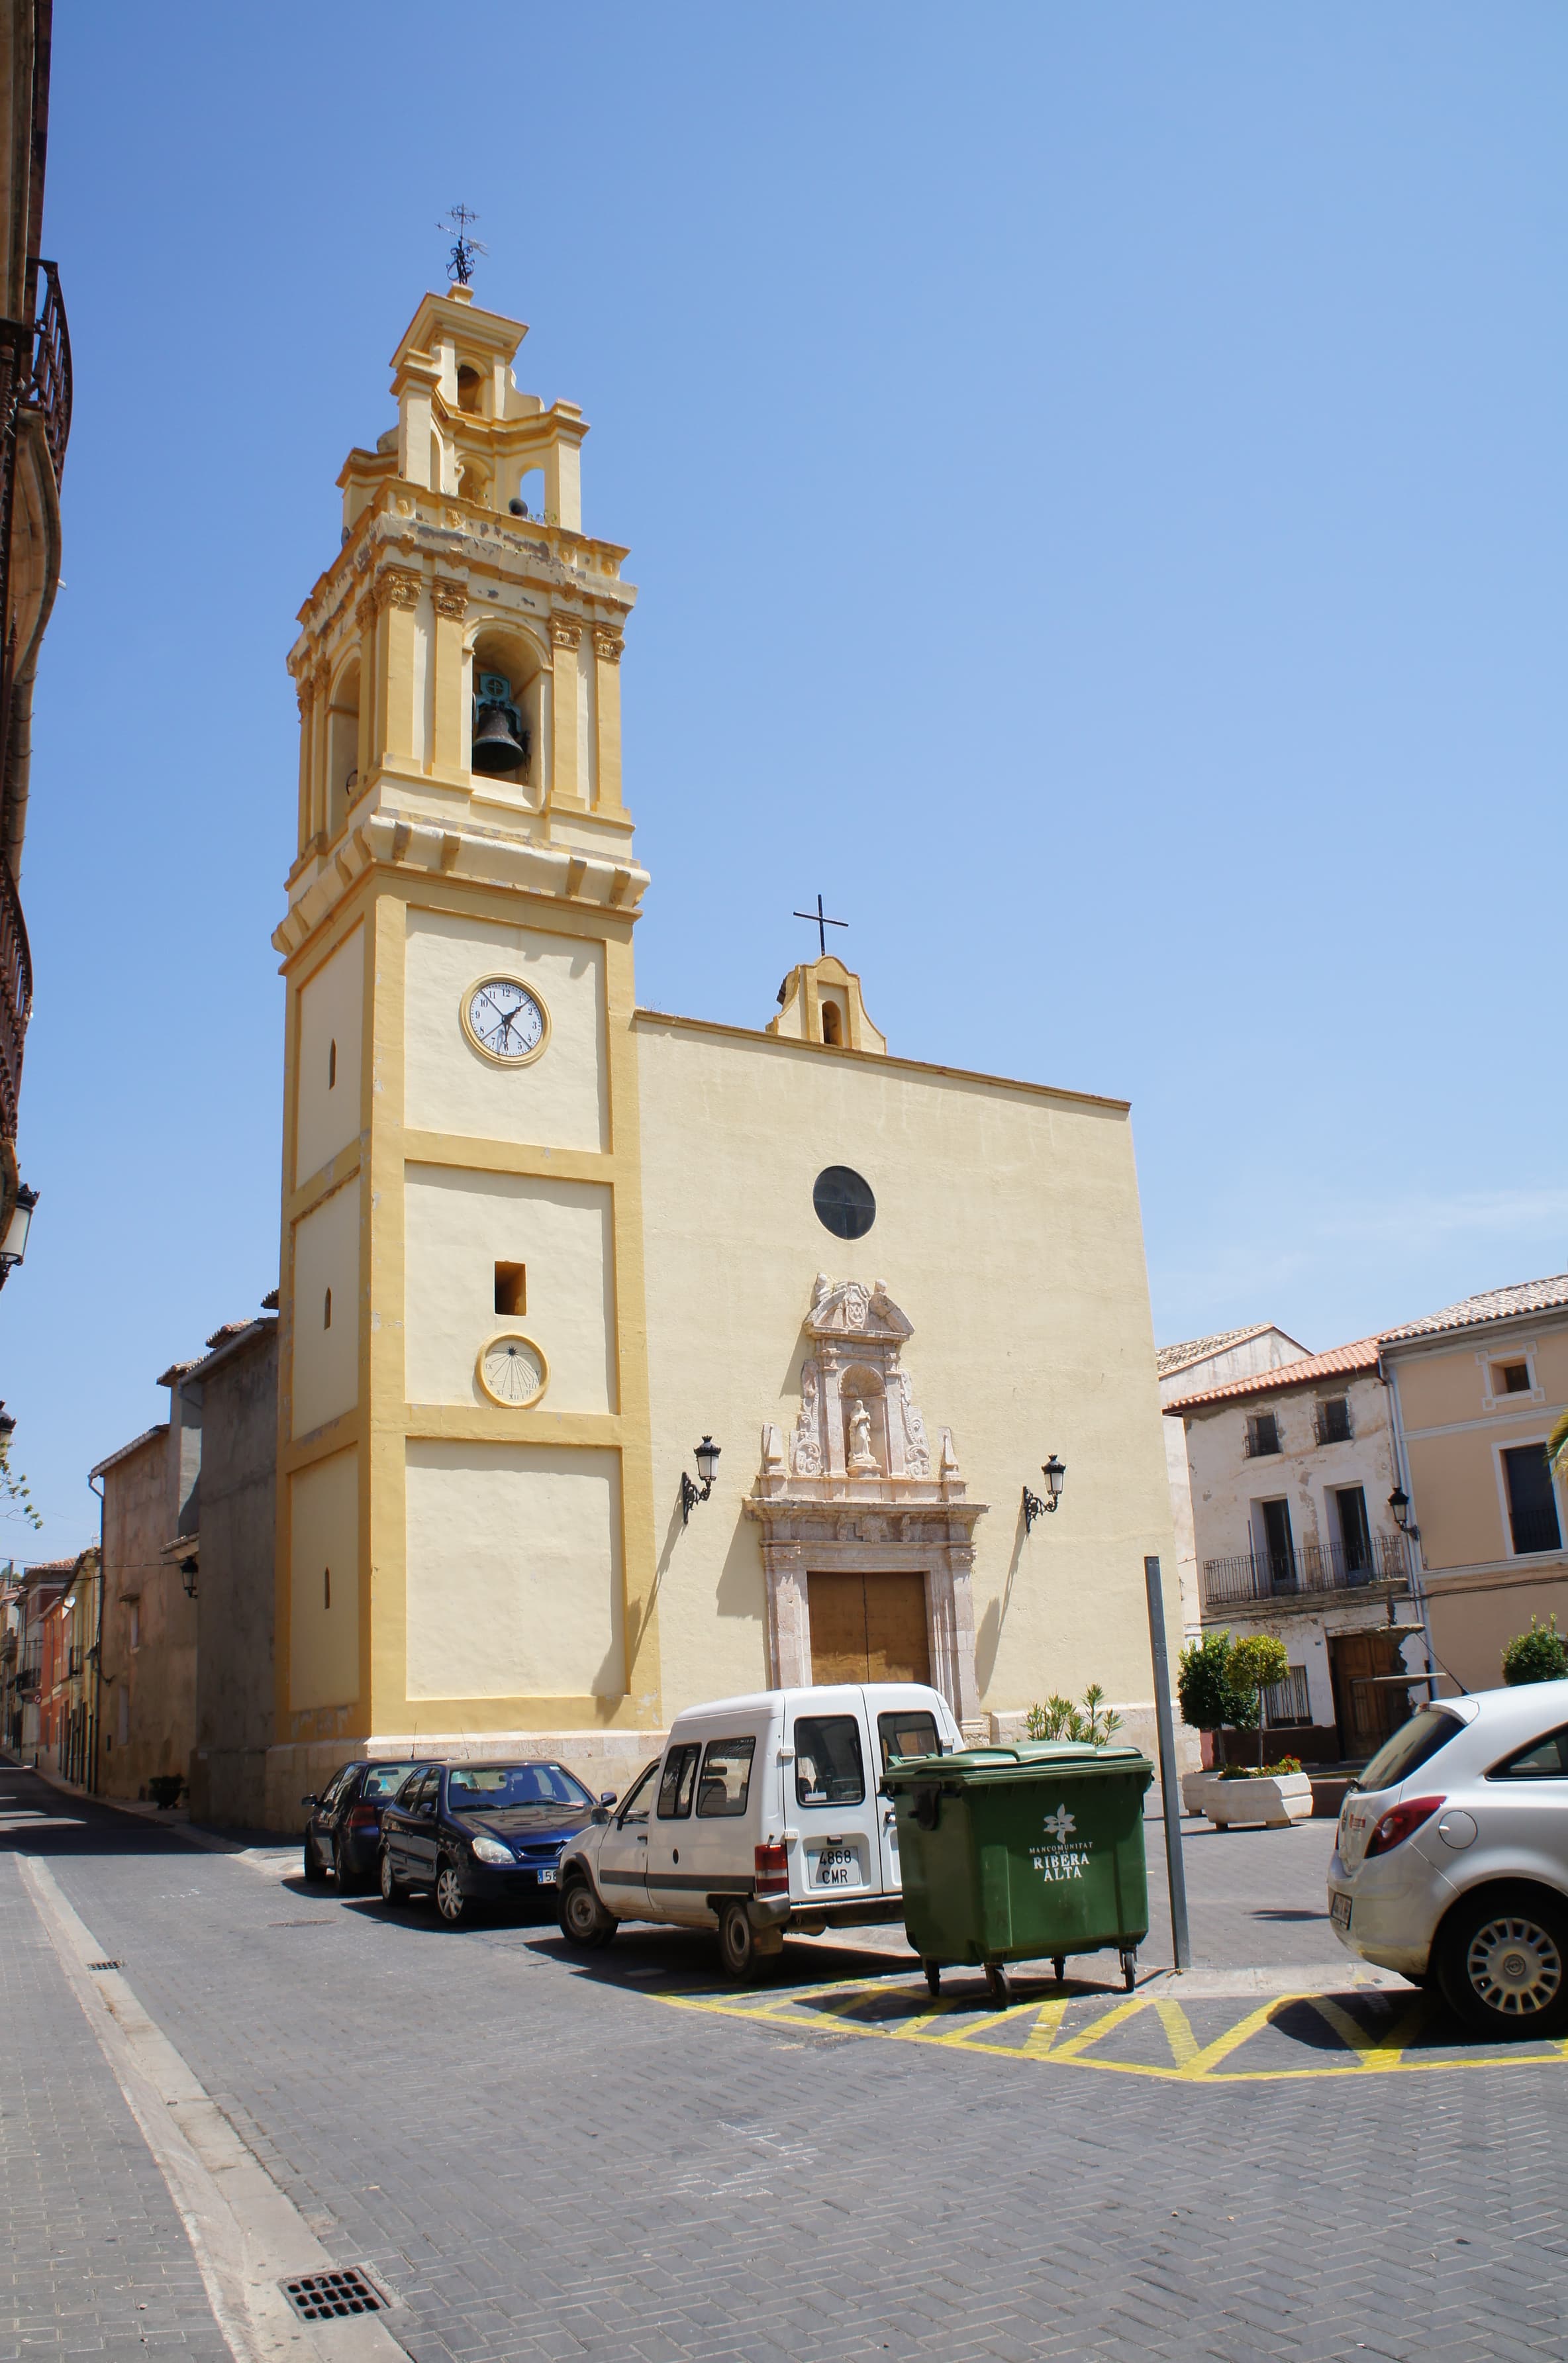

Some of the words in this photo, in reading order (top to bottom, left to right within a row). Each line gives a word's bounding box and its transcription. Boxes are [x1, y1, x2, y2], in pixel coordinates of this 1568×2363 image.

[518, 1041, 522, 1050] 5
[1028, 1841, 1093, 1854] MANCOMUNITAT
[820, 1850, 852, 1865] 4868
[1033, 1852, 1090, 1870] RIBERA
[822, 1869, 848, 1884] CMR
[1044, 1866, 1083, 1882] ALTA
